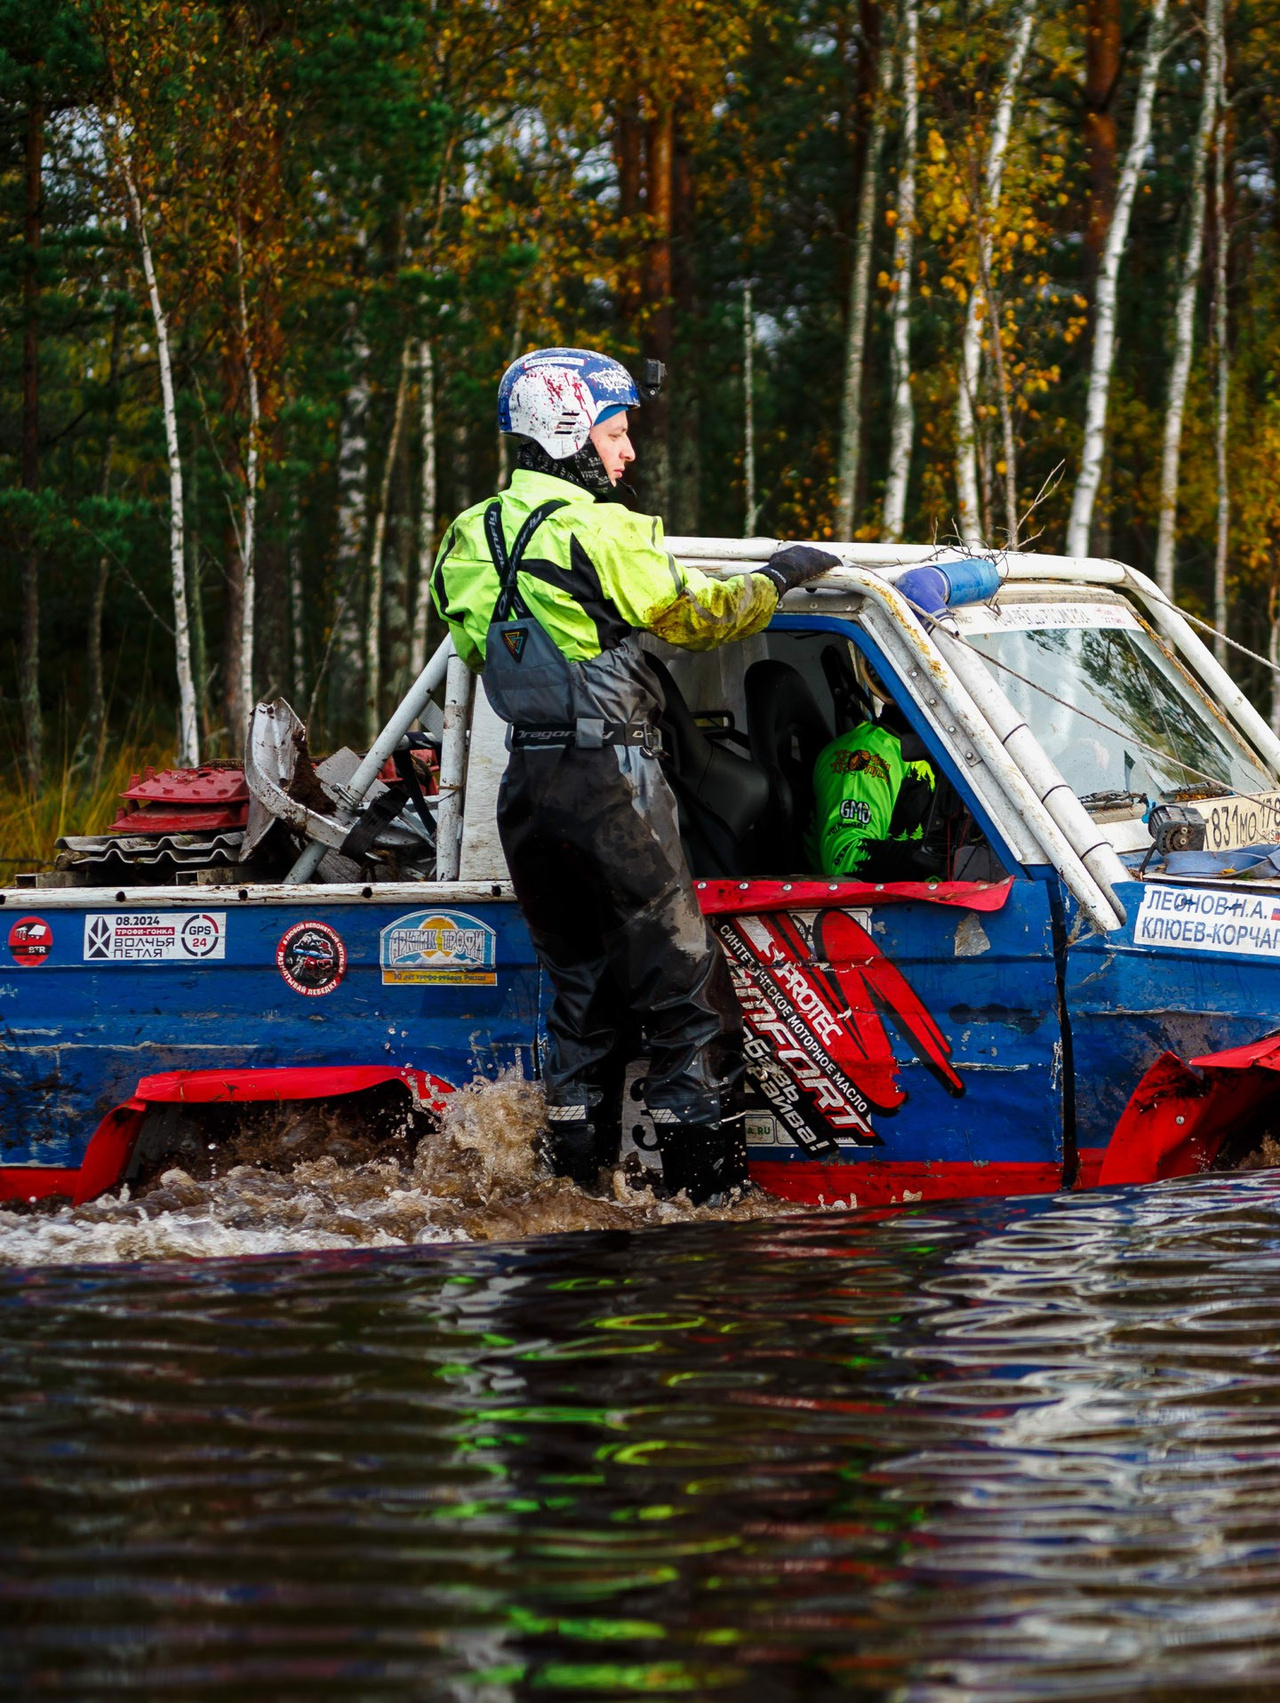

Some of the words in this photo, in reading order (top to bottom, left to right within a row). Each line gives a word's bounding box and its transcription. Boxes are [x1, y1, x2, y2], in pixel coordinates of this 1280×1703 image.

[1147, 890, 1227, 916] ЛЕОНОВ
[115, 916, 160, 926] 08.2024
[189, 925, 212, 935] GPS
[114, 937, 175, 947] ВОЛЧЬЯ
[192, 938, 207, 947] 24
[390, 929, 438, 961] АРКТИК
[441, 929, 485, 962] ТРОФИ
[113, 948, 163, 958] ПЕТЛЯ
[787, 1013, 837, 1074] МОТОРНОЕ
[832, 1072, 868, 1113] МАСЛО
